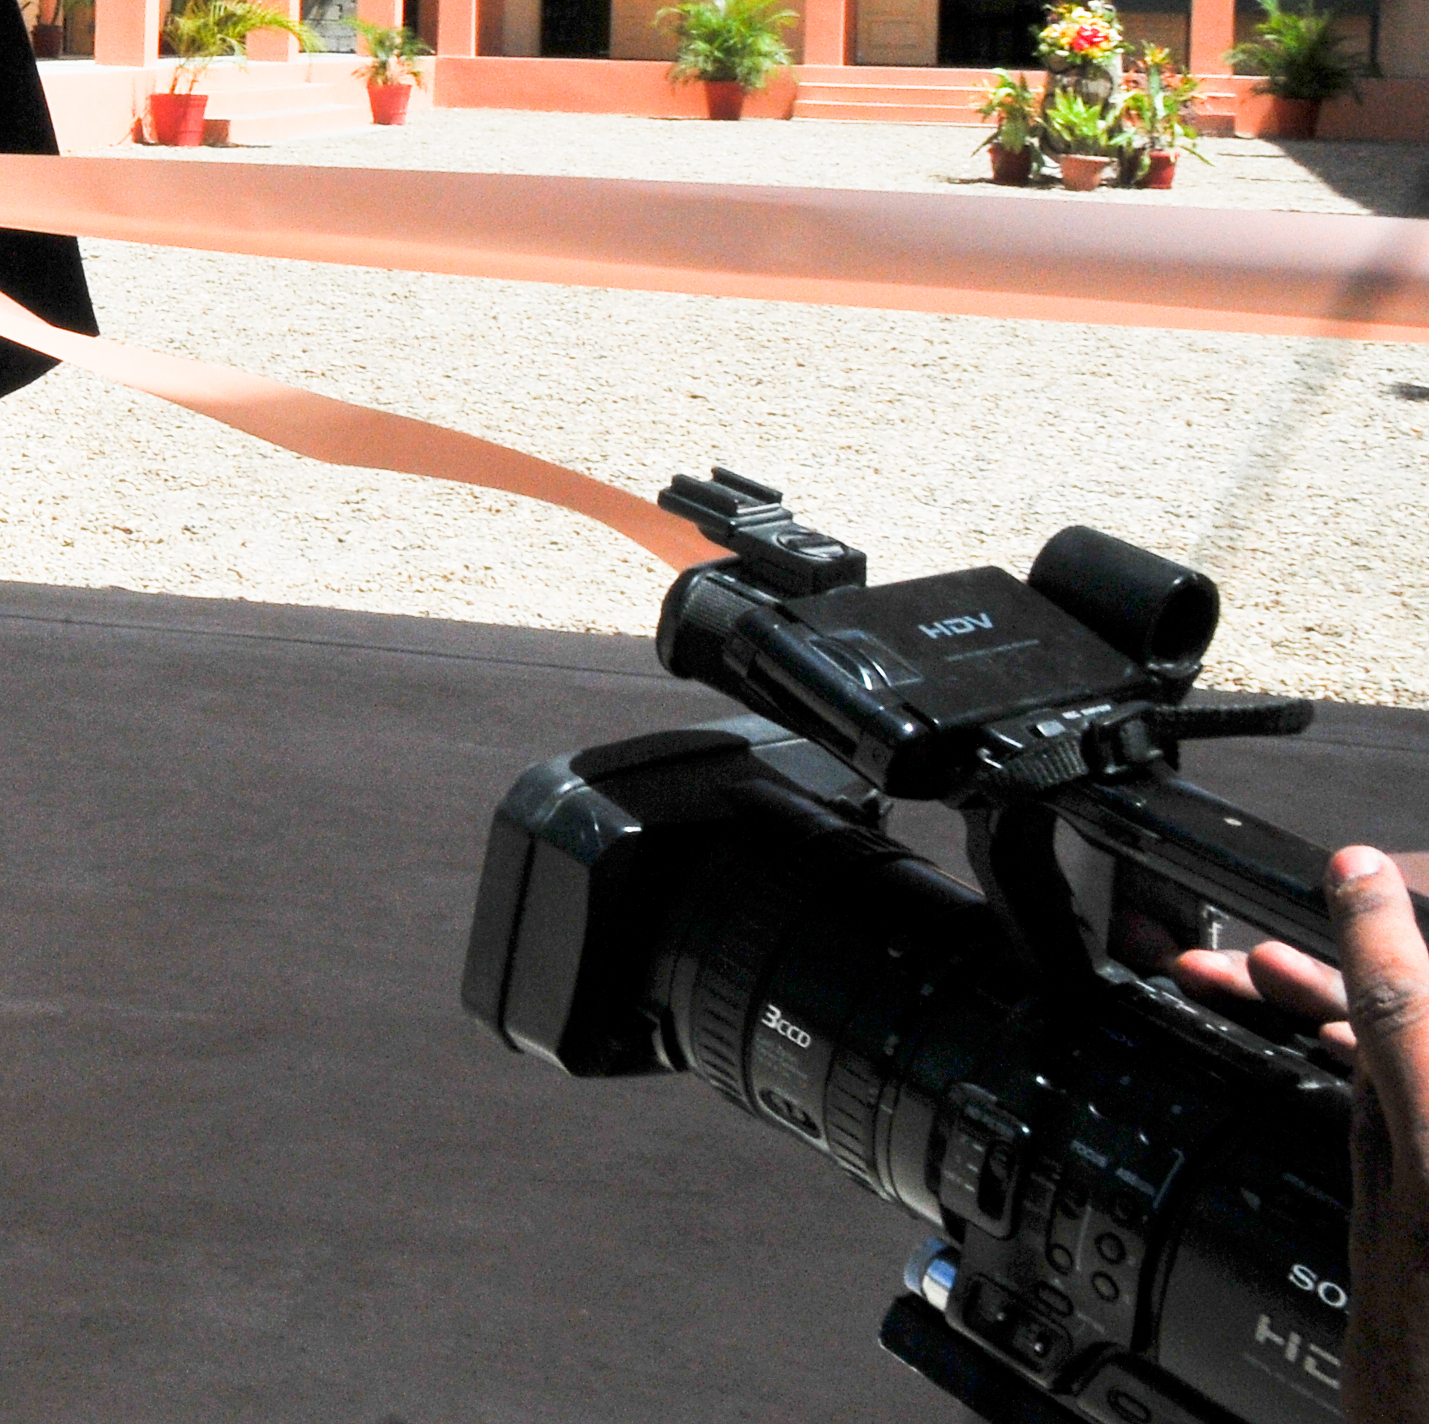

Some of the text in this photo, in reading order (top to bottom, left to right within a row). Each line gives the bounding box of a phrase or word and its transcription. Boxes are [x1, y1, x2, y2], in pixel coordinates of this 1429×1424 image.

[918, 612, 993, 639] HDV
[761, 1004, 811, 1049] 3CCD
[1288, 1263, 1350, 1314] SO
[1255, 1314, 1341, 1390] HD
